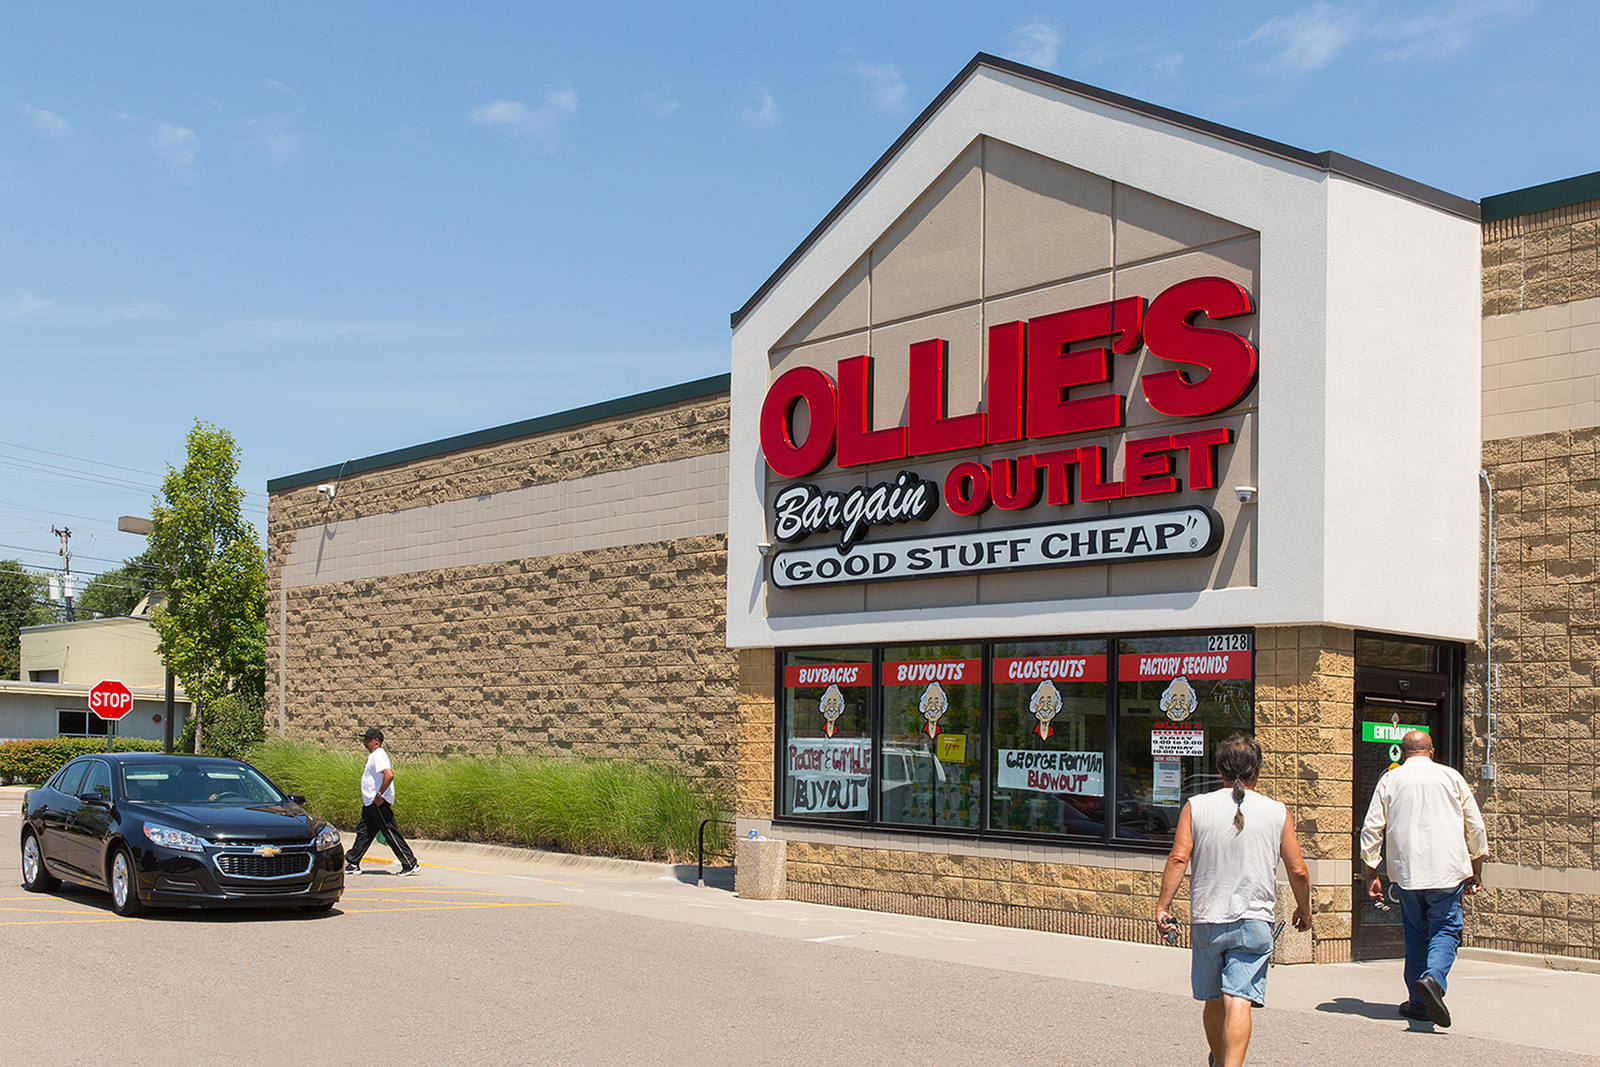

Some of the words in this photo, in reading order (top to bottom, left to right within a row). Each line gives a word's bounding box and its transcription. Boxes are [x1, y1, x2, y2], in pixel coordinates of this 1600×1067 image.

[760, 276, 1258, 477] OLLIE'S
[775, 473, 930, 545] Bargain
[944, 427, 1233, 516] OUTLET
[906, 537, 1032, 570] STUFF
[1208, 634, 1247, 651] 22128
[798, 666, 859, 684] BUYBACKS
[897, 662, 966, 682] BUYOUTS
[1008, 659, 1086, 679] CLOSEOUTS
[1139, 656, 1181, 676] FACTORY
[1181, 655, 1229, 675] SECONDS
[92, 692, 130, 708] STOP
[1374, 725, 1416, 740] ENTRAN
[1027, 769, 1088, 792] BLOWOUT
[794, 777, 868, 811] BUYOUT
